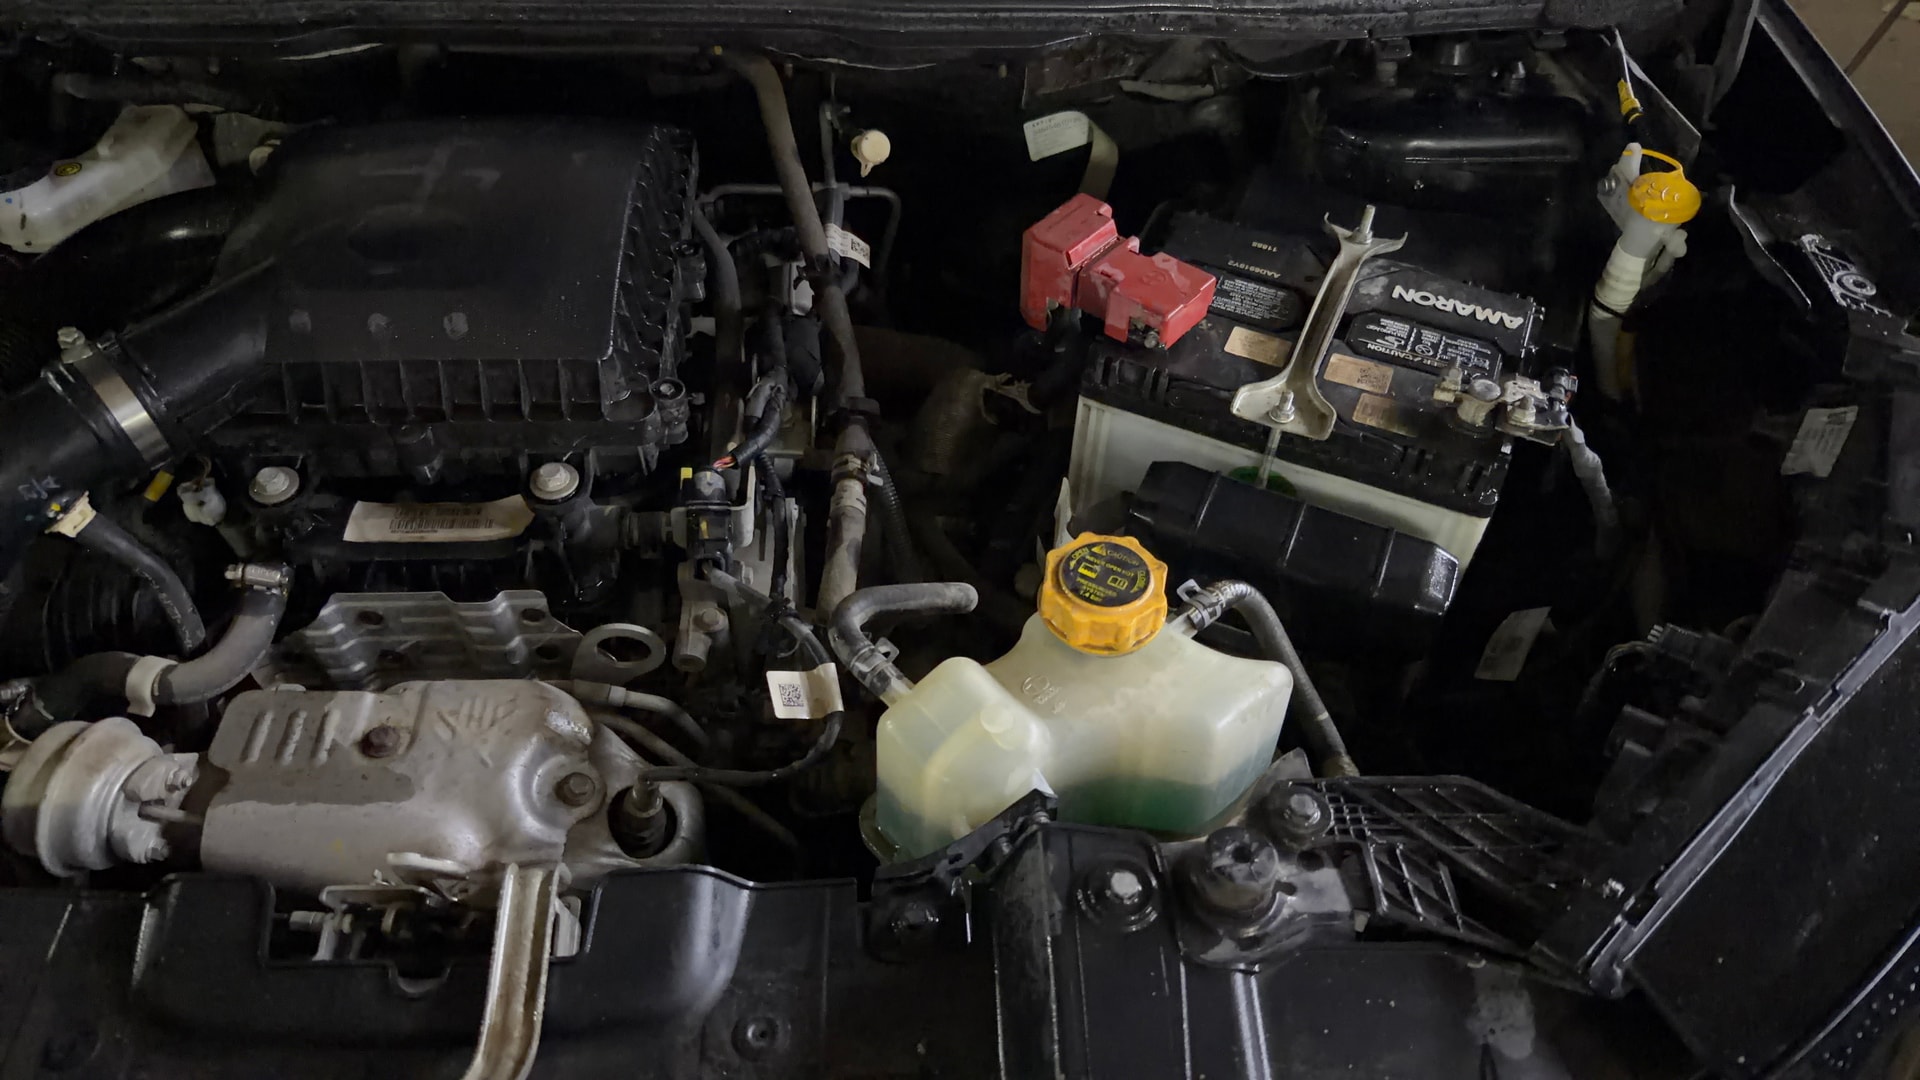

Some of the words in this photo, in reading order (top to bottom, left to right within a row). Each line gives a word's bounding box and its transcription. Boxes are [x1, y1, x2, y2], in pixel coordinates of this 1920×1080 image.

[1391, 284, 1524, 330] AMARON
[1366, 342, 1414, 362] CAUTION
[1071, 546, 1090, 559] OPEN
[1107, 549, 1140, 566] CAUTION
[1085, 554, 1106, 566] NEVER
[1105, 561, 1122, 573] OPEN
[1122, 568, 1135, 577] HOT
